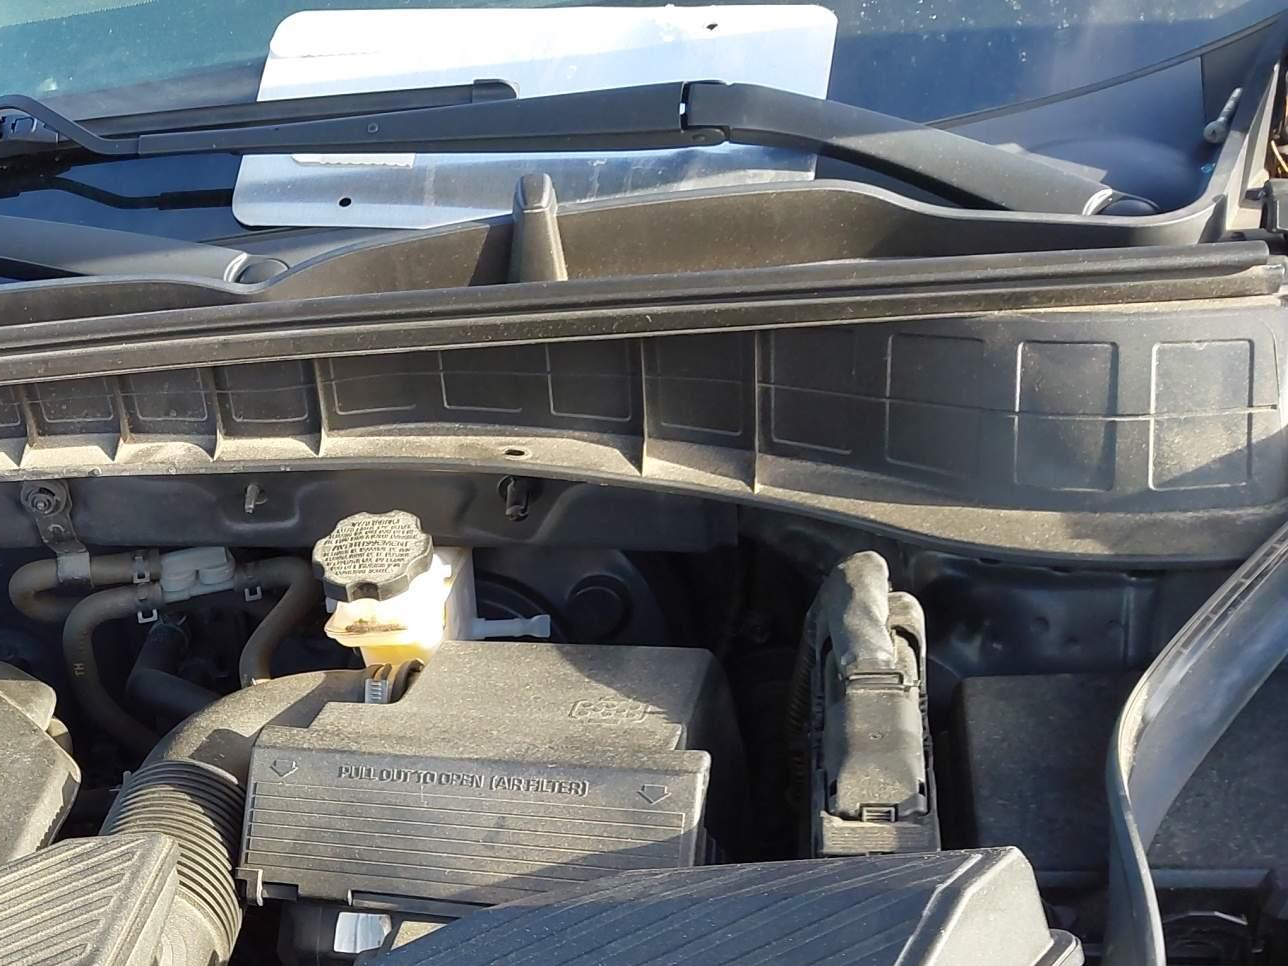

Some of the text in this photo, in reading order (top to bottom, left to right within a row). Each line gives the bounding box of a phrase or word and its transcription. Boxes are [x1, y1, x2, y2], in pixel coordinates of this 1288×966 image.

[337, 765, 377, 781] PULL
[379, 768, 415, 783] OUT
[415, 770, 438, 785] TO
[439, 772, 485, 789] OPEN
